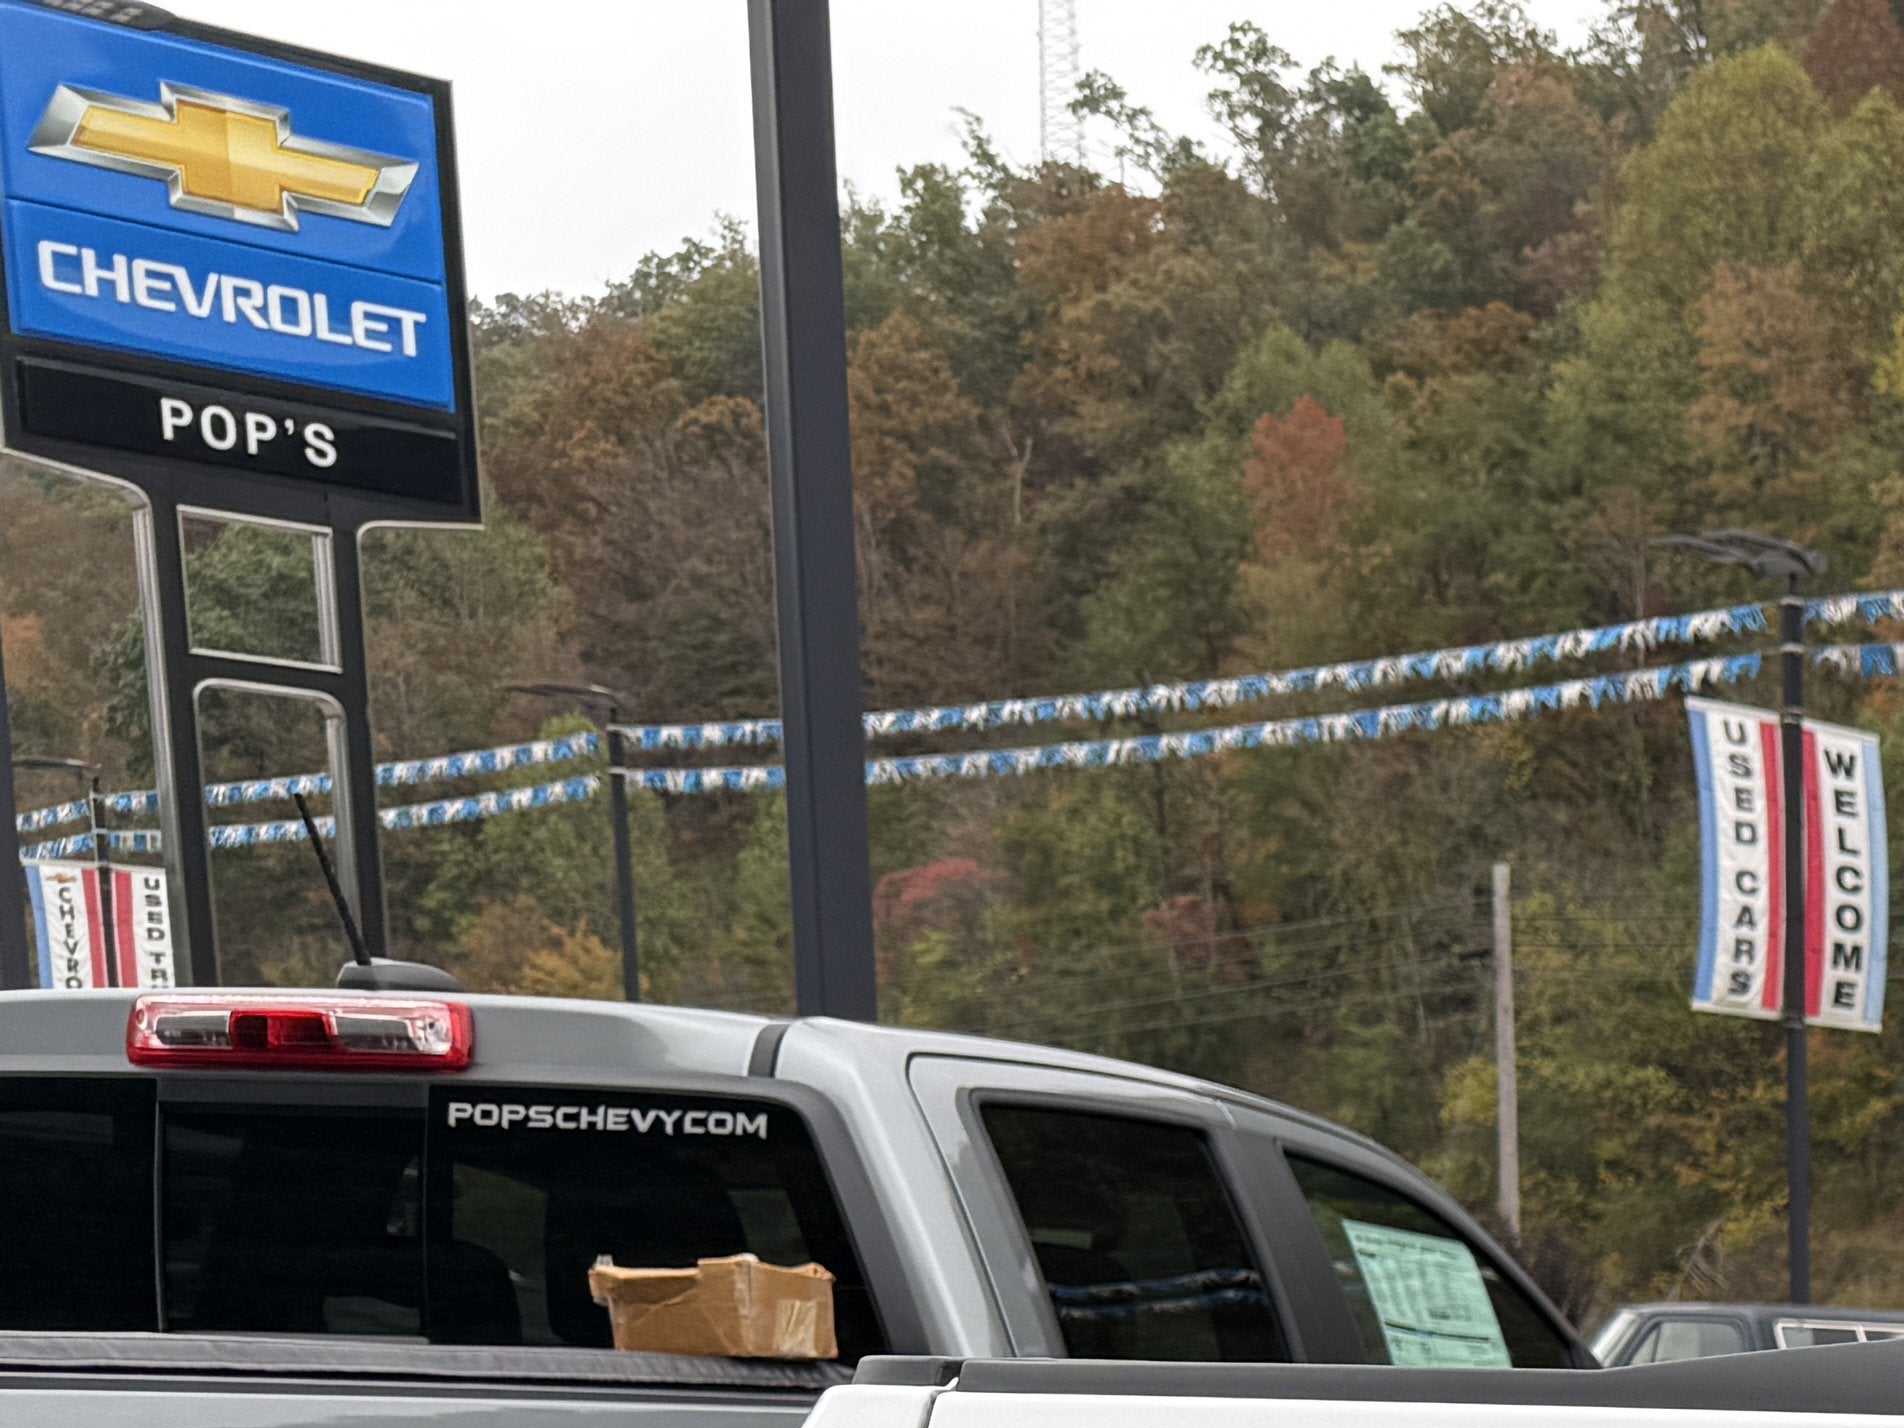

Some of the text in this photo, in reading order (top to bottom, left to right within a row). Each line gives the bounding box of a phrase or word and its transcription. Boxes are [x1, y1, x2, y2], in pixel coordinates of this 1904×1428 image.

[37, 239, 427, 358] CHEVROLET
[159, 396, 338, 469] POP'S
[1723, 719, 1759, 998] USED CARS
[1823, 748, 1864, 1009] WELCOME
[143, 876, 169, 988] USED TR
